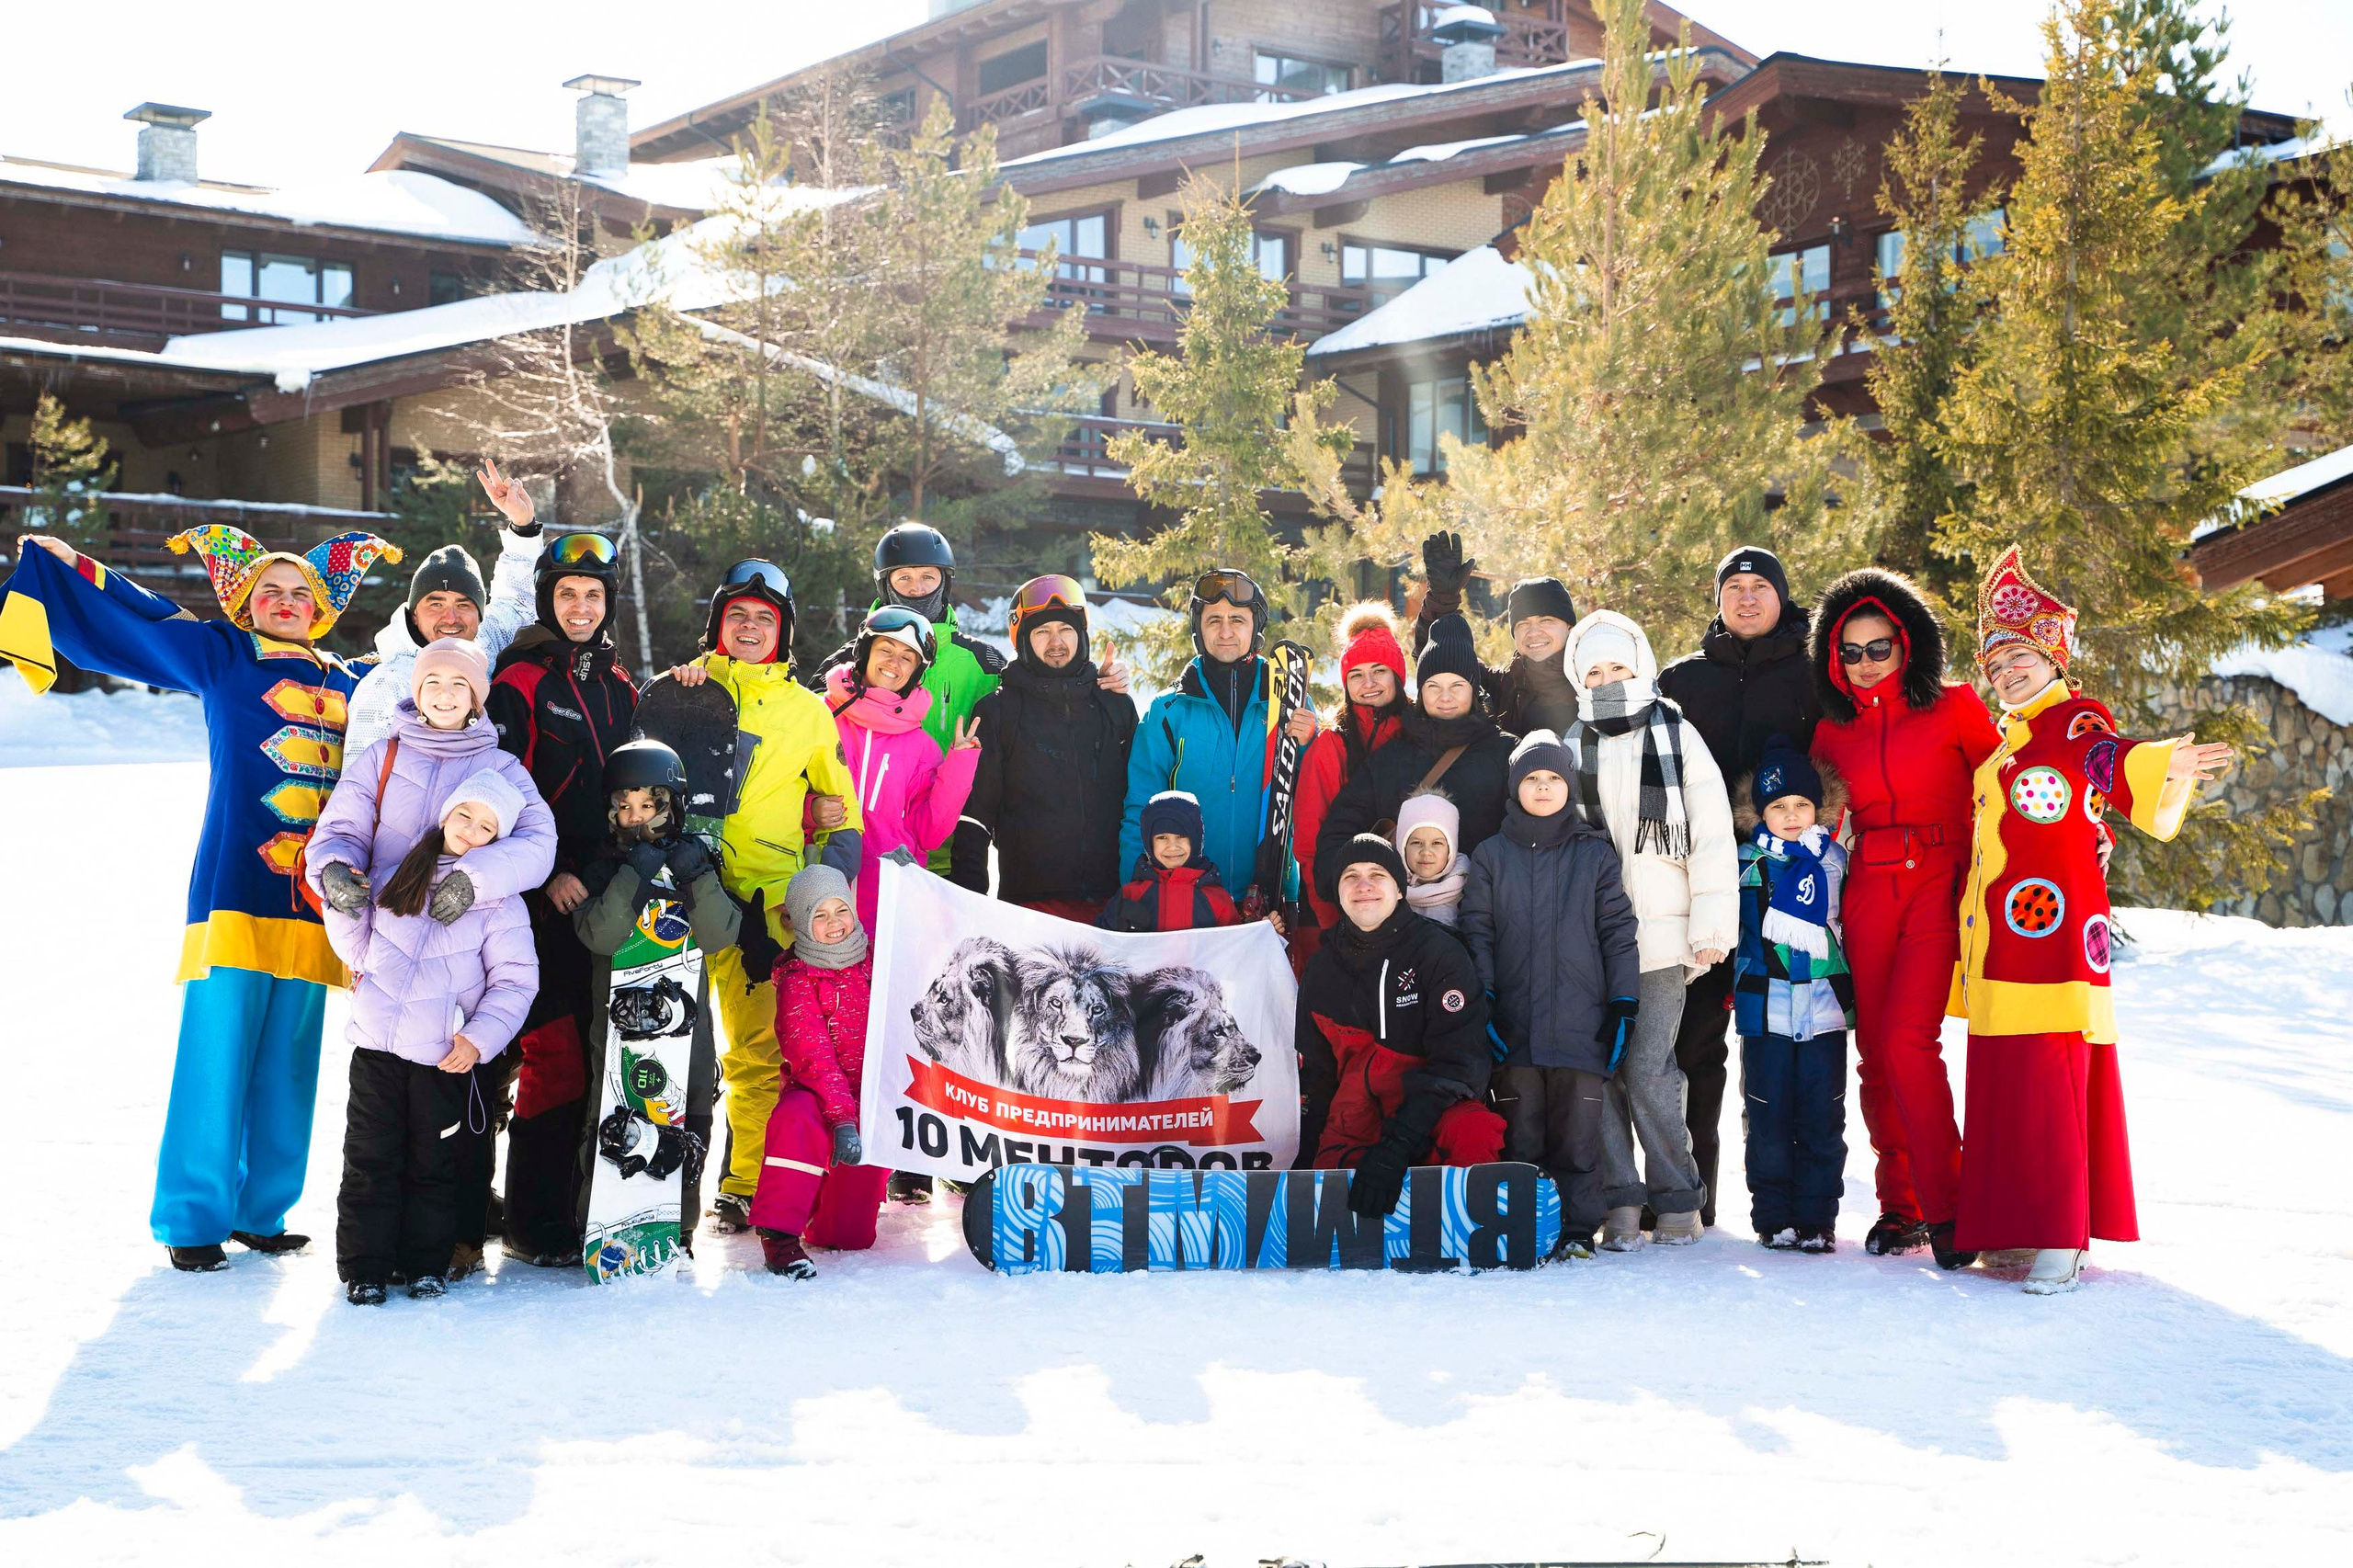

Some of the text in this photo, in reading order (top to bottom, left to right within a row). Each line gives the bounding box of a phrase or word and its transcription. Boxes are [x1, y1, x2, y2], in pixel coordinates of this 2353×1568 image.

[1396, 993, 1418, 1004] SNOW
[945, 1082, 1213, 1131] КЛУБ ПРЕДПРИНИМАТЕЛЕЙ
[895, 1106, 949, 1158] 10
